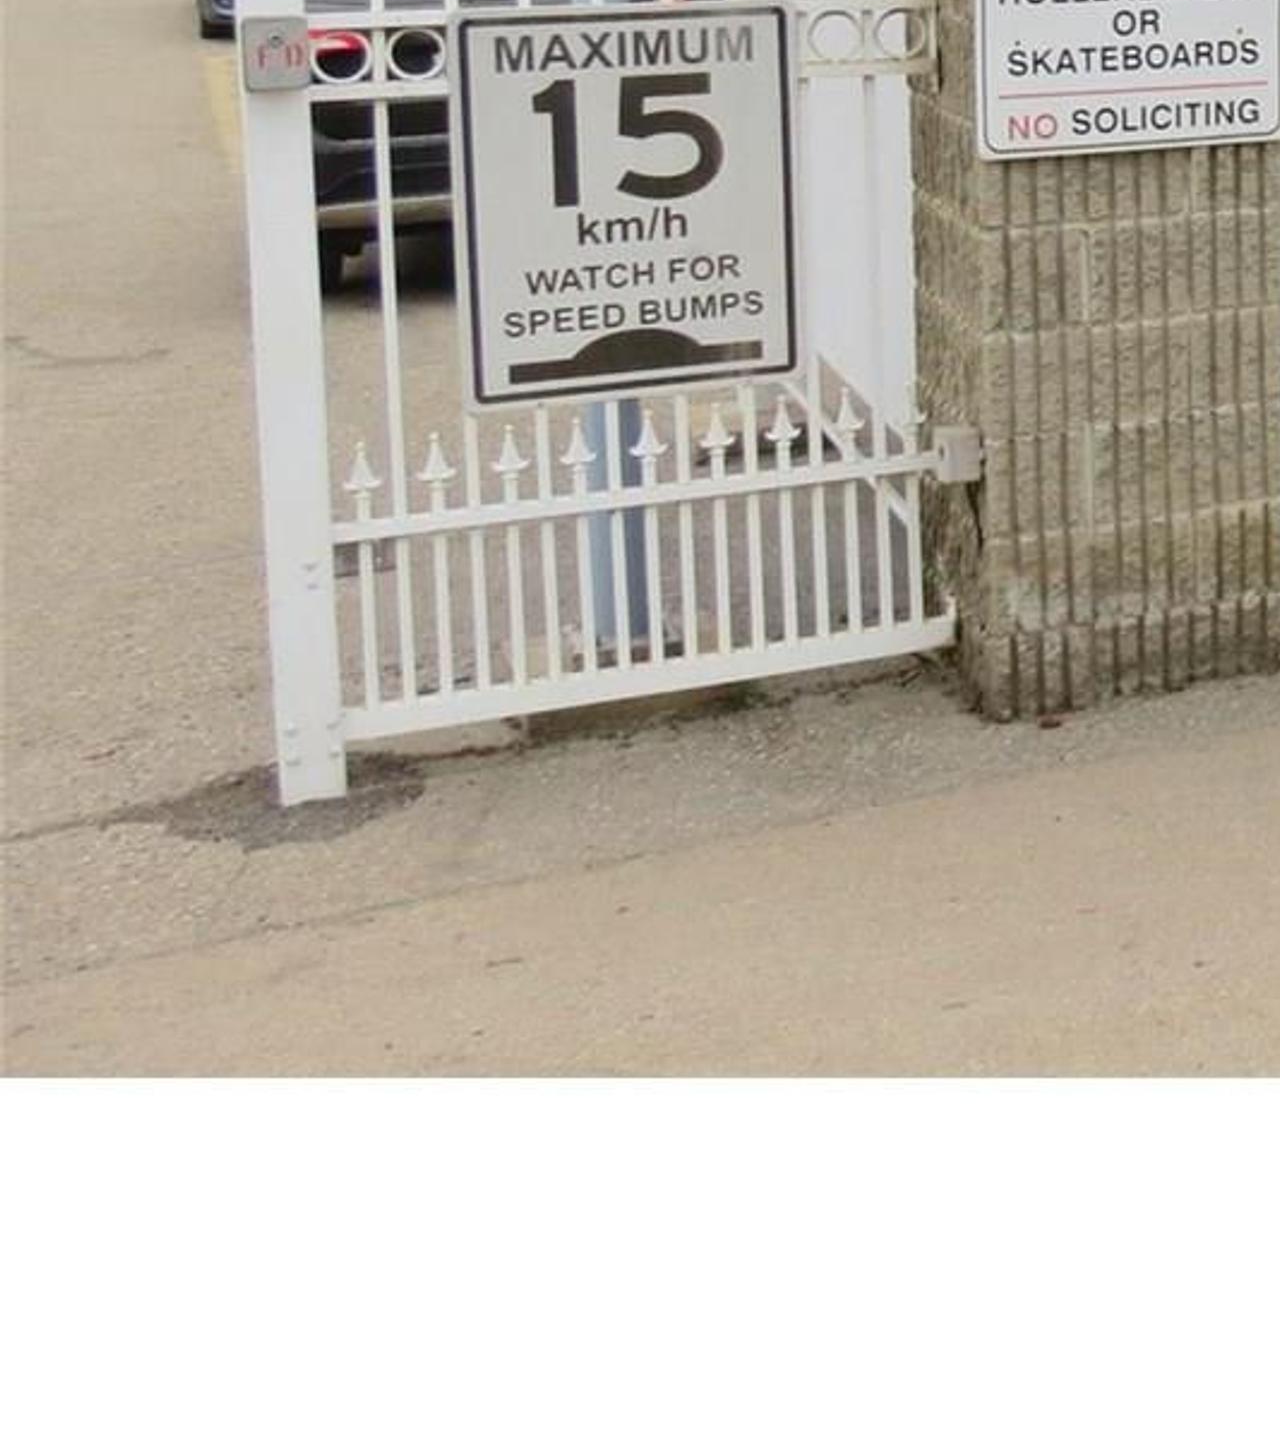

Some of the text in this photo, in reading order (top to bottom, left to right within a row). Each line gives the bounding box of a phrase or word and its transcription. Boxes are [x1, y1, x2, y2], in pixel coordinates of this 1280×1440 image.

[1113, 11, 1160, 36] OR
[495, 26, 754, 72] MAXIMUM
[1008, 39, 1259, 76] SKATEBOARDS
[532, 72, 724, 208] 15
[1008, 99, 1259, 140] NO SOLICITING
[577, 206, 688, 245] km/h
[525, 254, 740, 295] WATCH FOR
[504, 290, 764, 337] SPEED BUMPS
